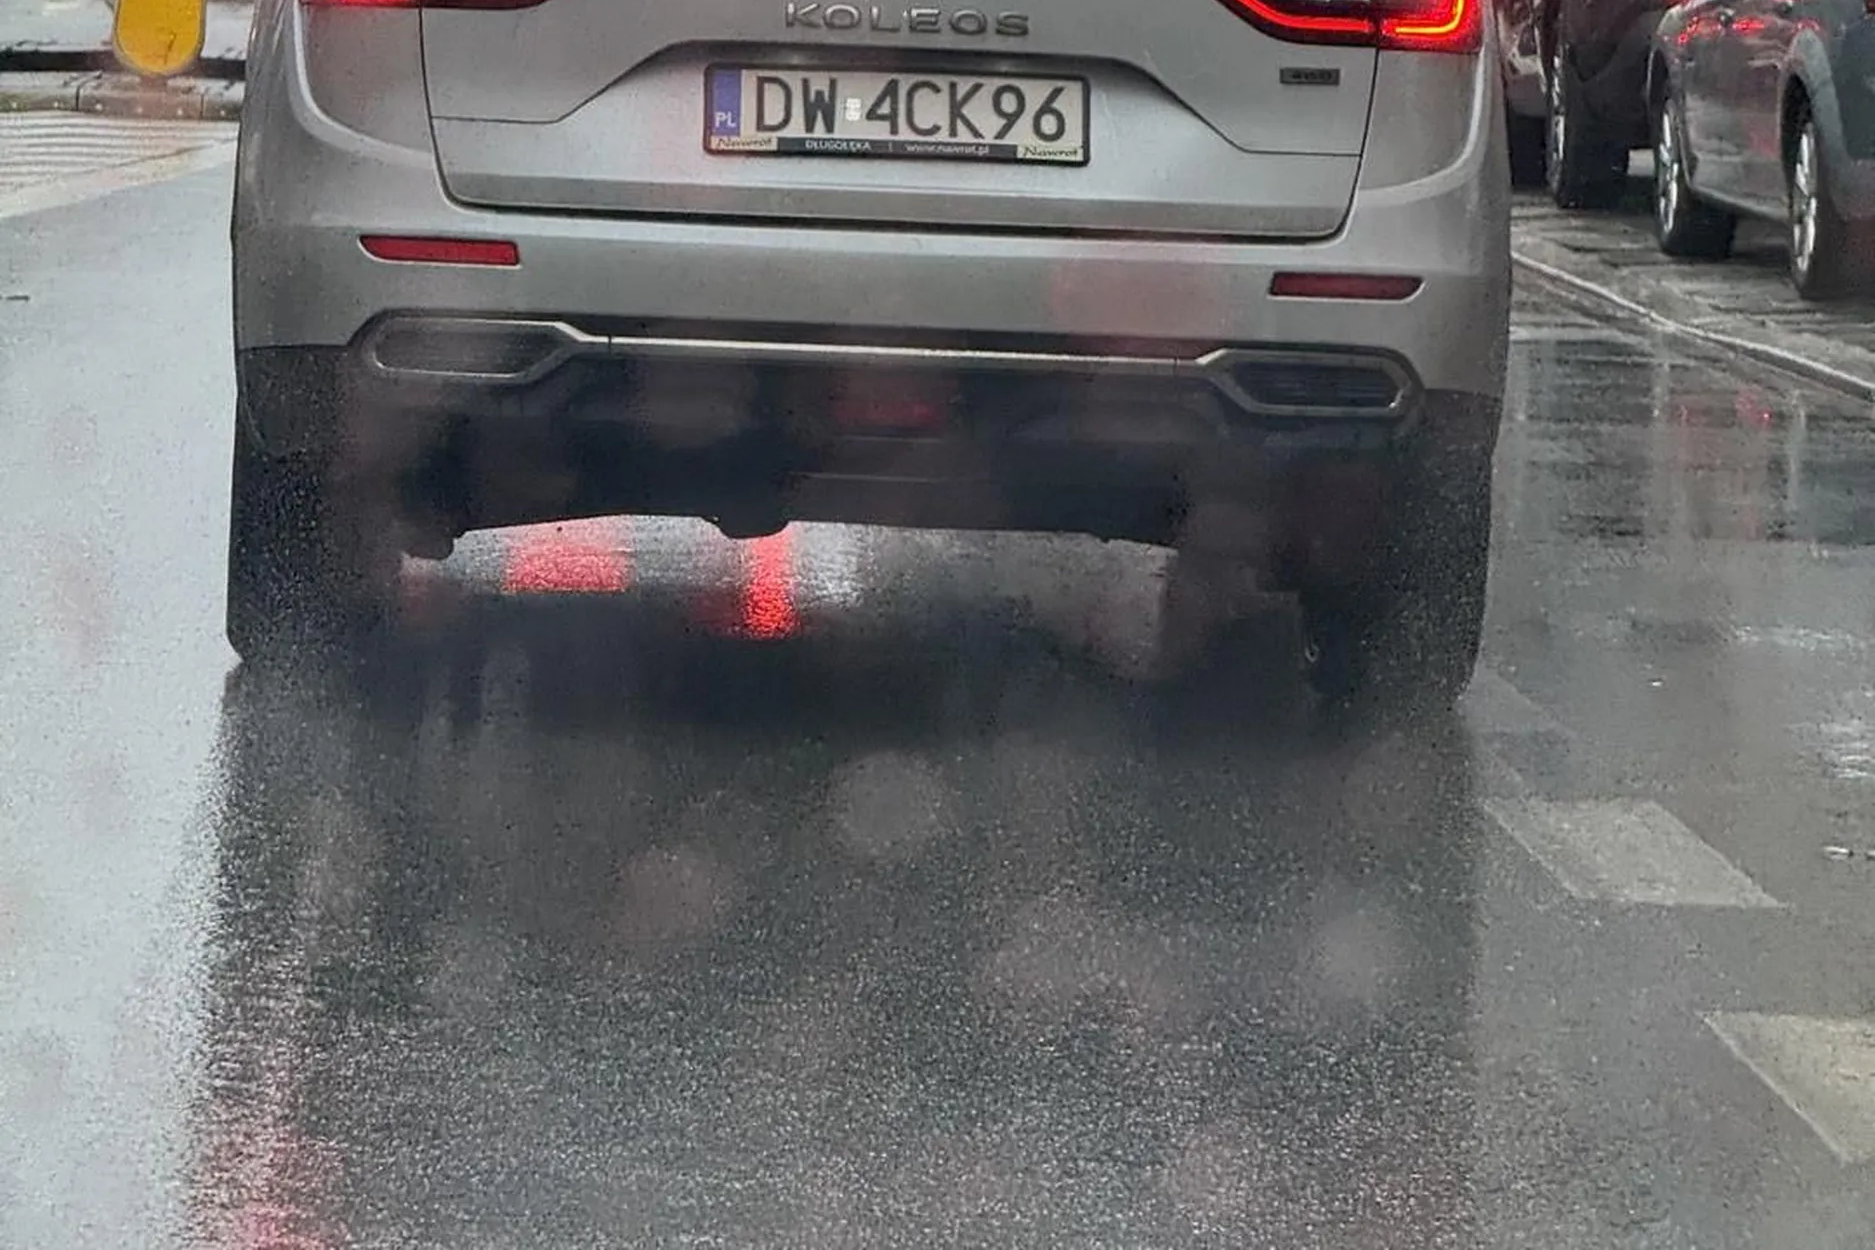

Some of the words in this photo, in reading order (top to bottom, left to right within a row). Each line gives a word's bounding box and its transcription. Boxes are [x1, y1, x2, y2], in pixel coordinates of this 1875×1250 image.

[785, 1, 1030, 37] KOLEOS
[715, 112, 737, 128] PL
[756, 75, 837, 135] DW
[865, 78, 1066, 143] 4CK96
